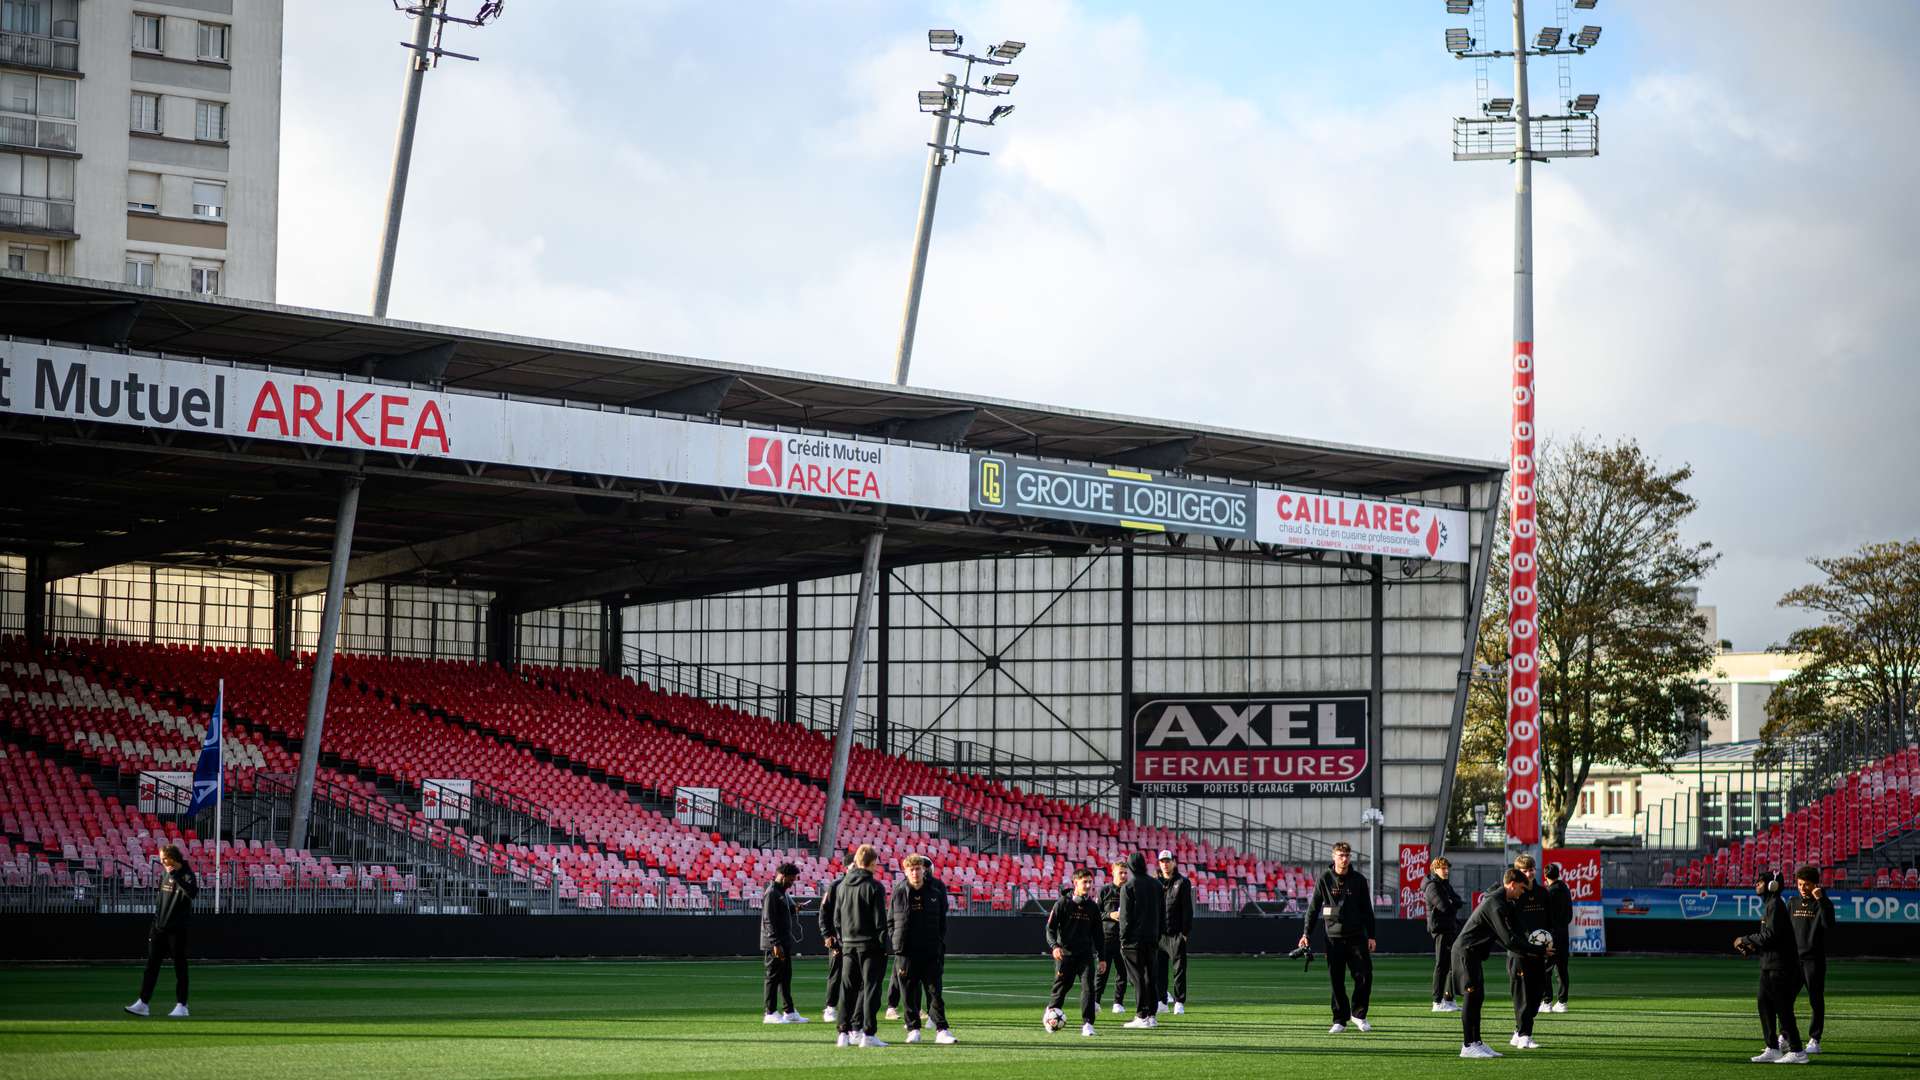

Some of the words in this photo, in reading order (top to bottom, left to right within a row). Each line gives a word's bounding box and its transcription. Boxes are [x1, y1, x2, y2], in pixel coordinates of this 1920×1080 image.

[35, 358, 225, 429] Mutuel
[247, 380, 450, 453] ARKEA
[788, 439, 830, 458] Crédit
[833, 443, 881, 464] Mutuel
[787, 463, 880, 499] ARKEA
[1016, 472, 1114, 511] GROUPE
[1124, 485, 1246, 526] LOBLIGEOIS
[1276, 494, 1420, 534] CAILLAREC
[1279, 523, 1302, 534] chaud
[1304, 526, 1310, 535] &
[1312, 527, 1329, 537] froid
[1331, 529, 1340, 538] en
[1341, 530, 1366, 541] cuisine
[1368, 533, 1420, 546] professionnelle
[1145, 703, 1356, 746] AXEL
[1144, 756, 1355, 776] FERMETURES
[1142, 783, 1188, 793] FENETRES
[1203, 783, 1239, 793] PORTES
[1242, 783, 1255, 793] DE
[1258, 783, 1294, 793] GARAGE
[1310, 782, 1355, 793] PORTAILS
[1407, 863, 1425, 881] Cola
[1852, 896, 1899, 919] TOP
[1571, 938, 1601, 951] MALO
